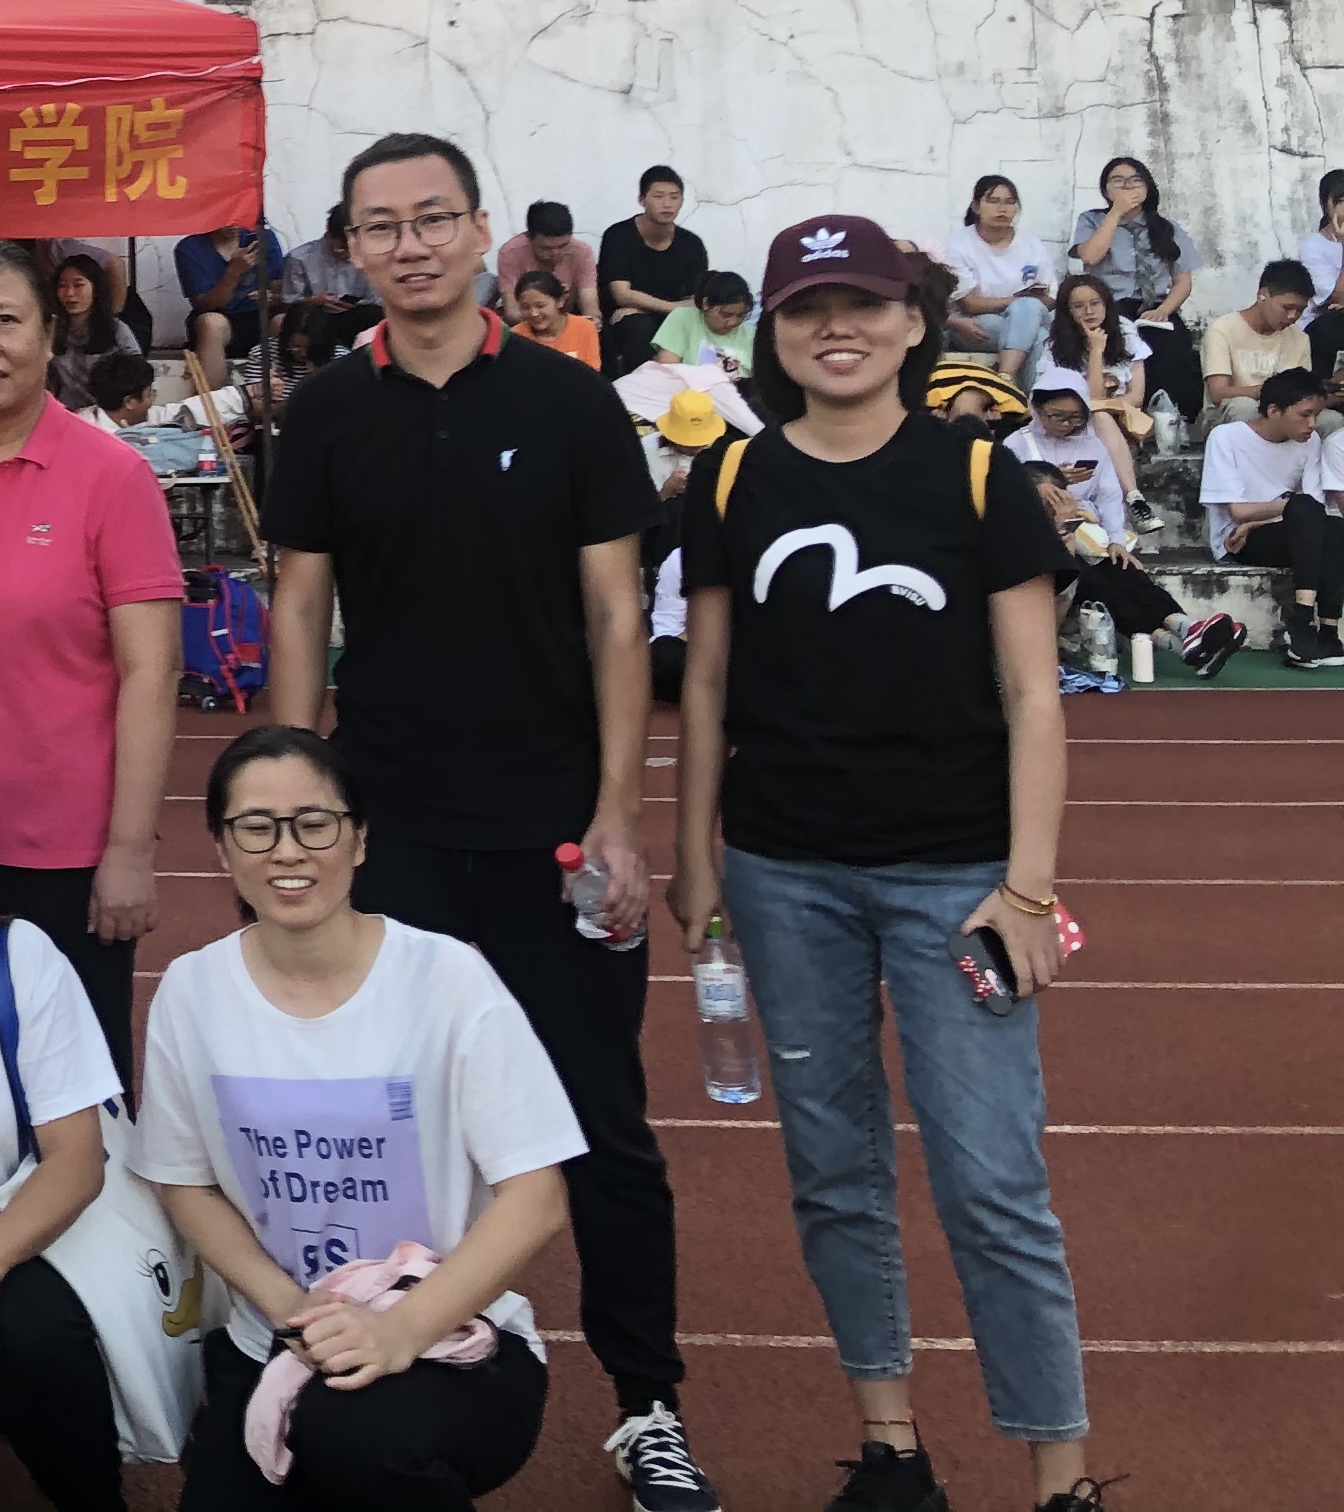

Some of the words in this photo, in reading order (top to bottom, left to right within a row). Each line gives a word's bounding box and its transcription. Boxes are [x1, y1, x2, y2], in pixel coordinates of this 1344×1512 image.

[239, 1126, 288, 1159] The
[293, 1129, 386, 1161] Power
[284, 1171, 390, 1204] Dream
